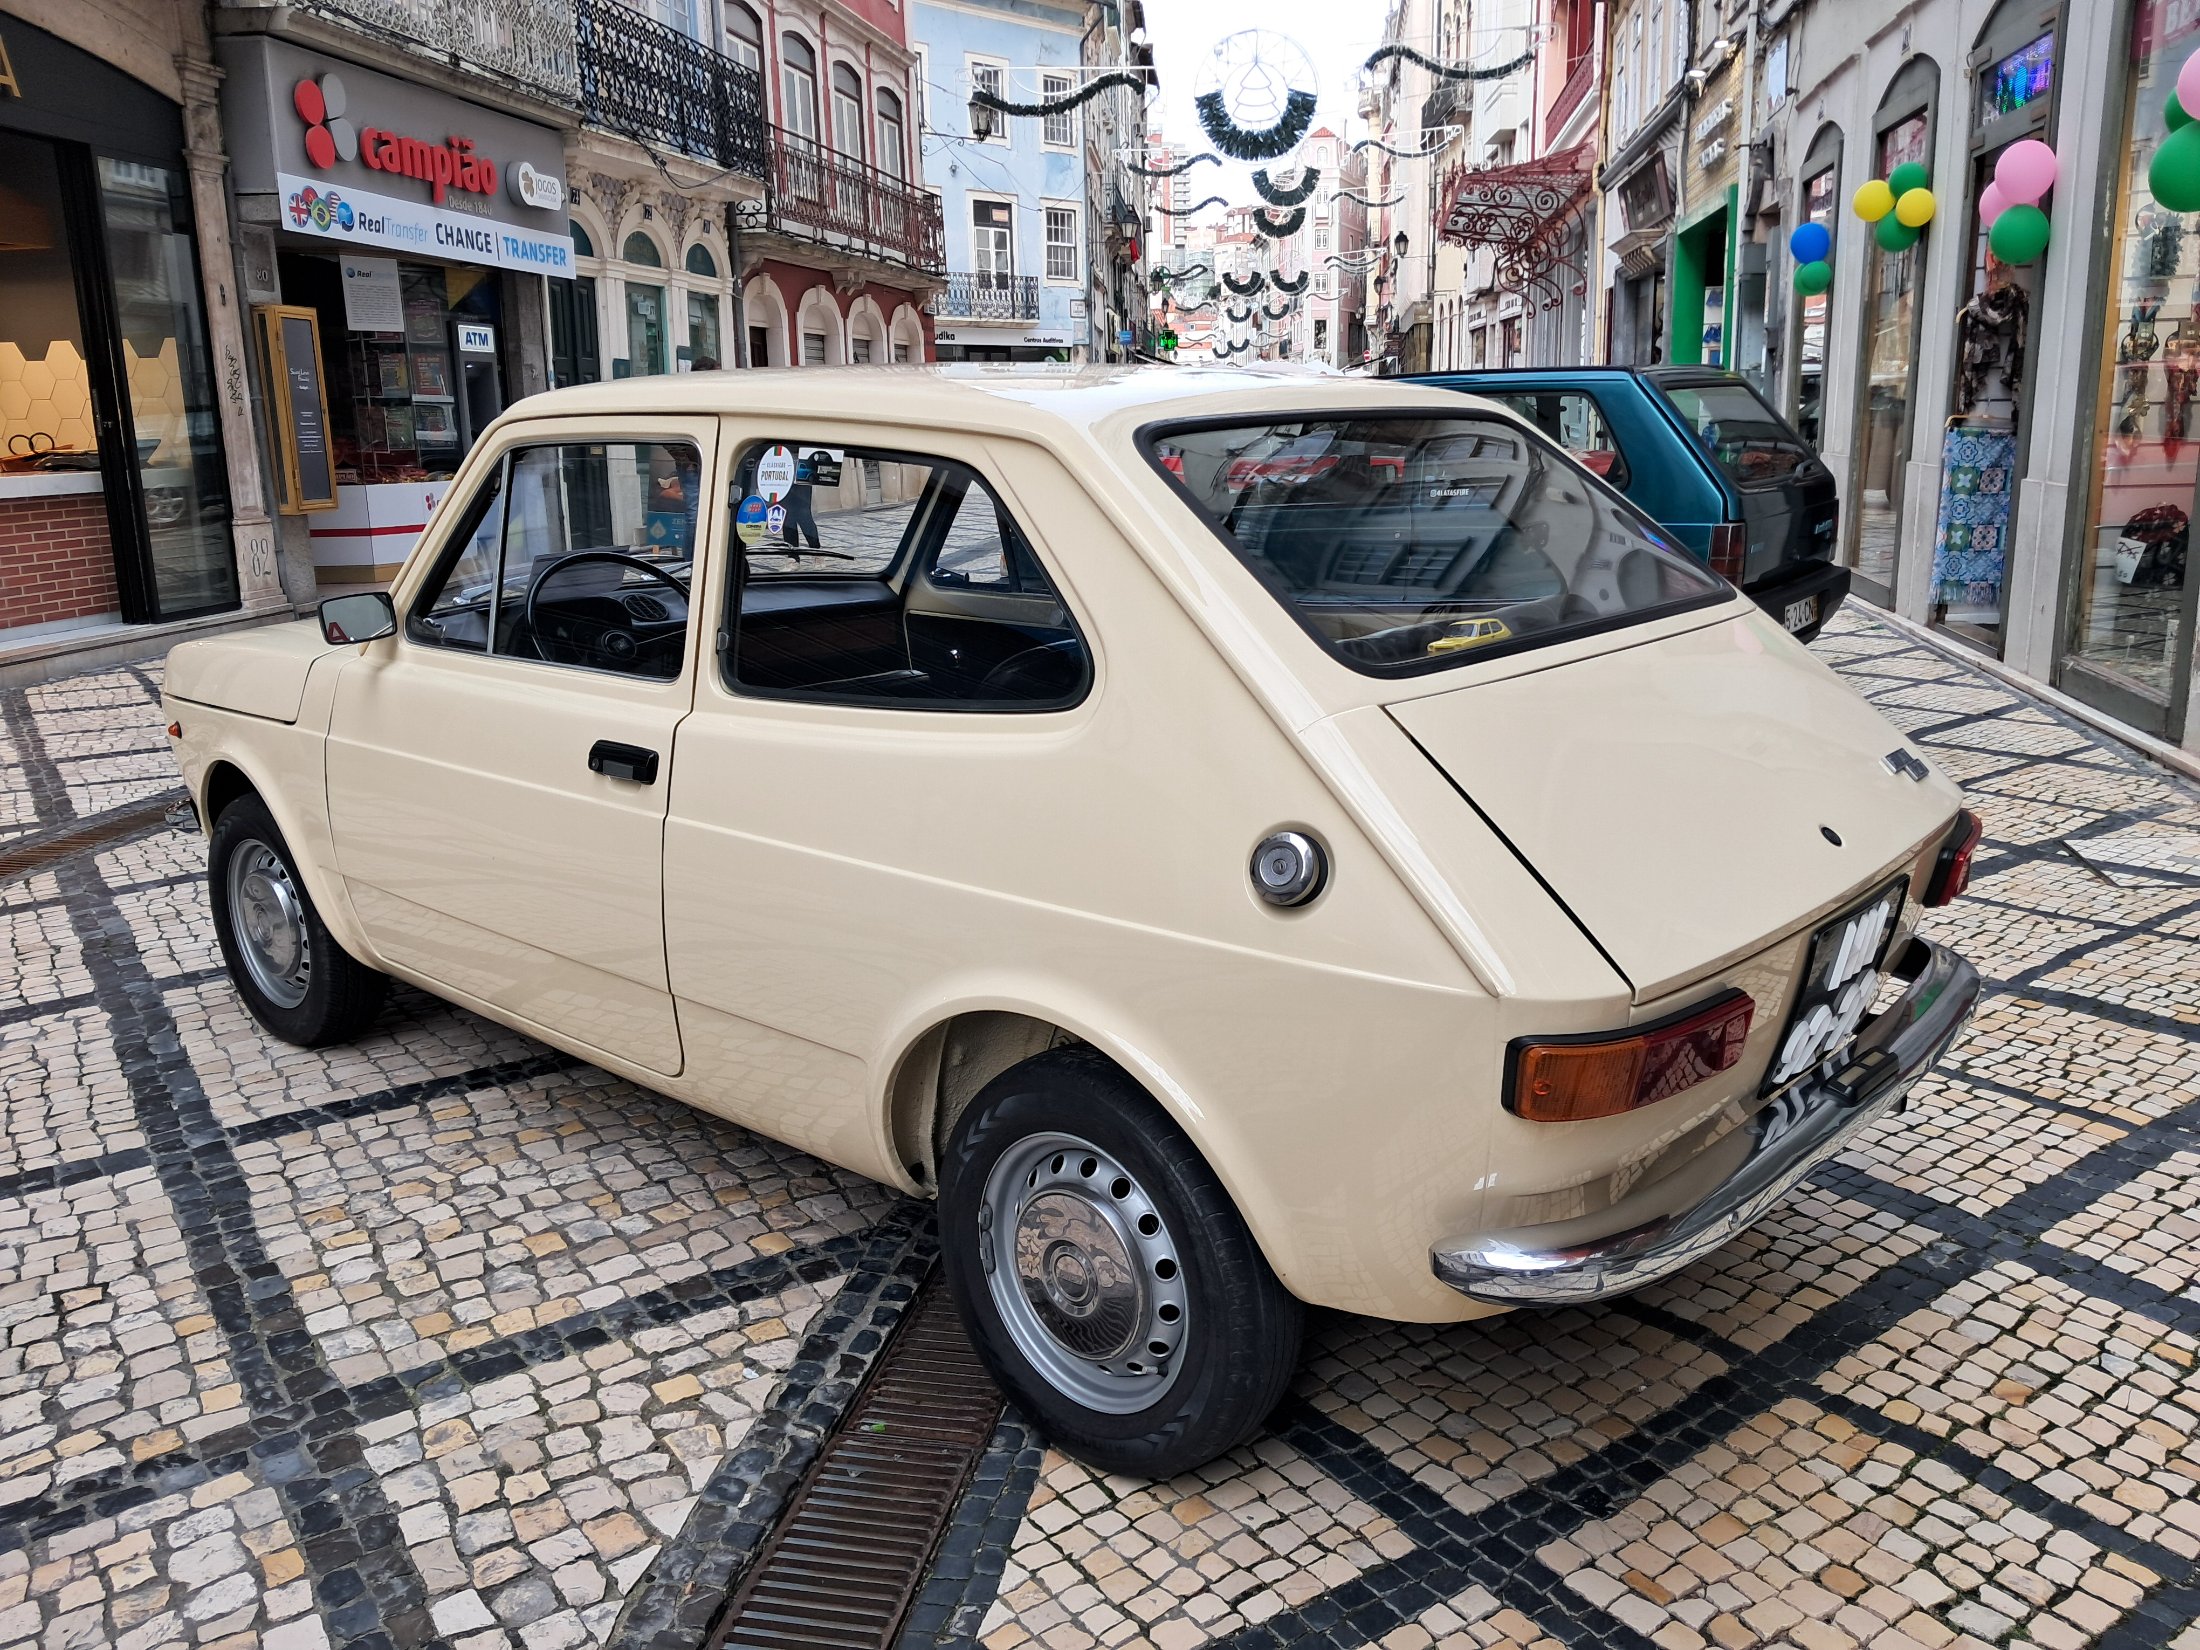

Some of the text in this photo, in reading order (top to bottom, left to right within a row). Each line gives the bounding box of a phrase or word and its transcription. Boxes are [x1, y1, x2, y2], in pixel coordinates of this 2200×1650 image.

[360, 126, 498, 206] campião
[535, 177, 557, 195] JOGOS
[448, 195, 473, 213] Desde
[435, 222, 493, 254] CHANGE
[502, 236, 567, 267] TRANSFER
[256, 268, 269, 282] 80
[465, 331, 489, 347] ATM
[1023, 336, 1042, 344] Centros
[760, 470, 789, 481] PORTUGAL
[250, 538, 272, 578] 82
